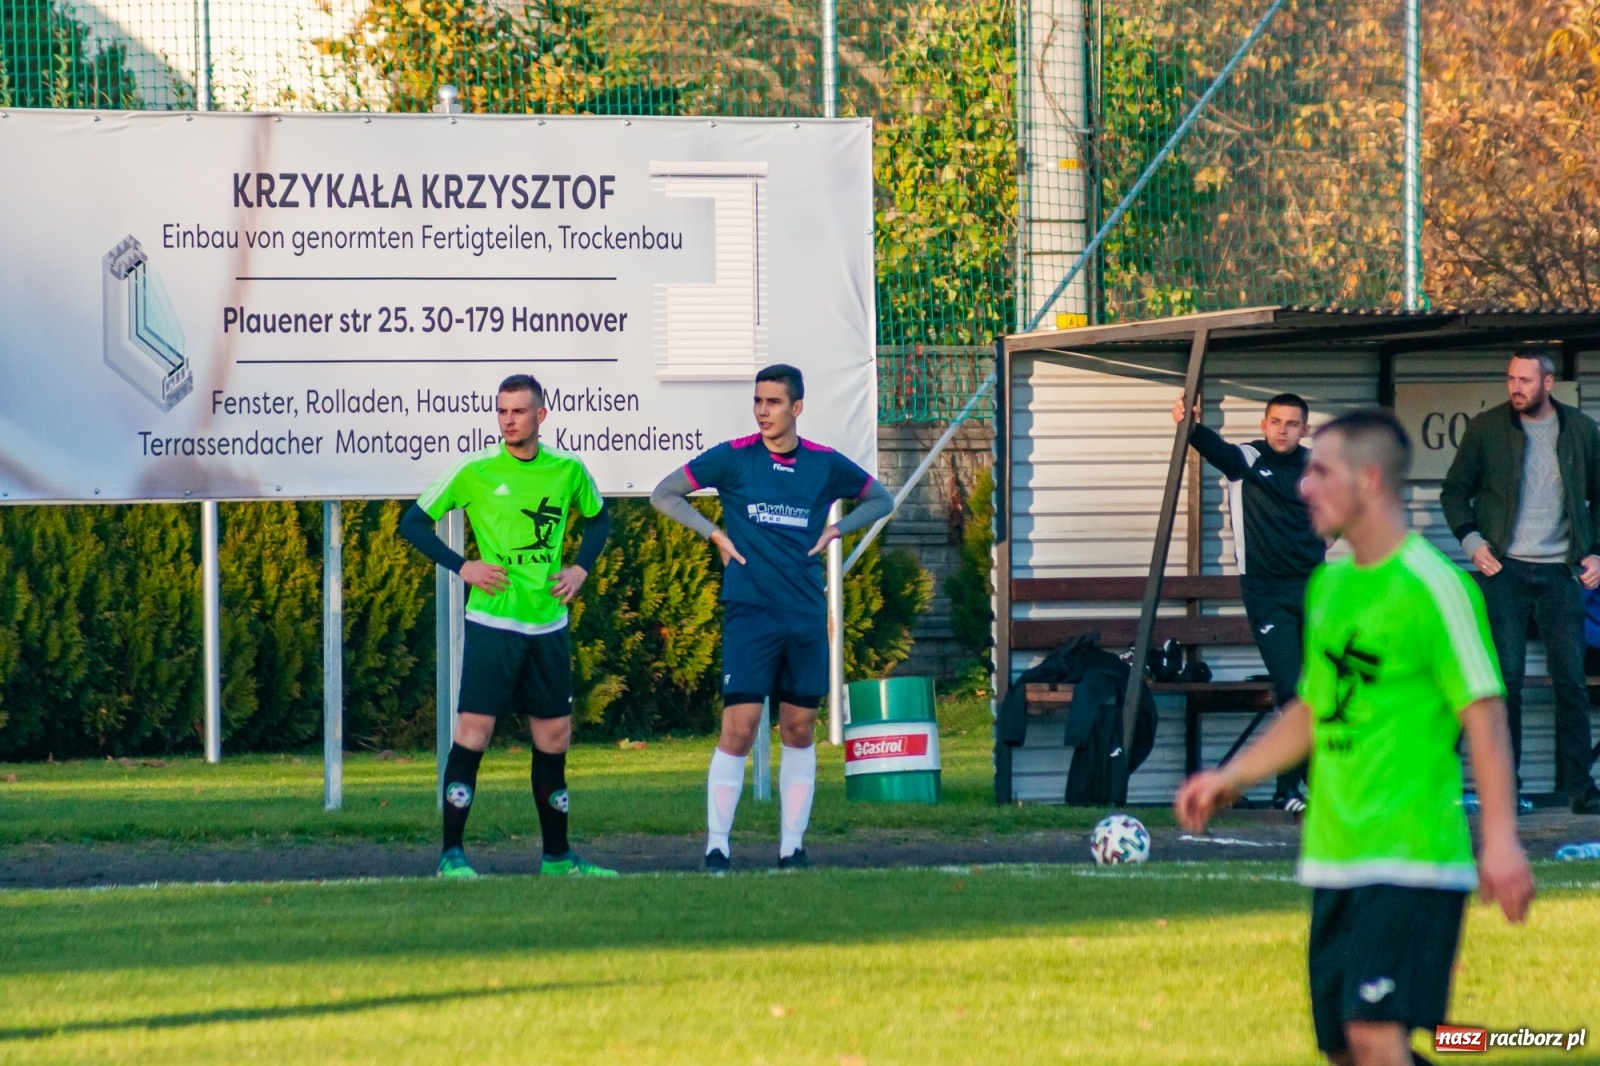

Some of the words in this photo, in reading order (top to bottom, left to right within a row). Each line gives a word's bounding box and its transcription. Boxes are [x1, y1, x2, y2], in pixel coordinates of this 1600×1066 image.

[234, 173, 412, 208] KRZYKAŁA
[422, 174, 615, 209] KRZYSZTOF
[163, 223, 238, 248] Einbau
[245, 231, 284, 248] von
[292, 227, 413, 256] genormten
[422, 224, 552, 256] Fertigteilen,
[558, 225, 682, 249] Trockenbau
[224, 306, 333, 333] Plauener
[340, 309, 371, 333] str
[378, 307, 414, 332] 25.
[422, 306, 504, 332] 30-179
[513, 307, 627, 332] Hannover
[212, 390, 298, 417] Fenster,
[307, 389, 408, 416] Rolladen,
[543, 388, 639, 412] Markisen
[138, 430, 323, 456] Terrassendacher
[336, 430, 449, 460] Montagen
[556, 427, 704, 452] Kundendienst
[862, 739, 903, 756] Castrol
